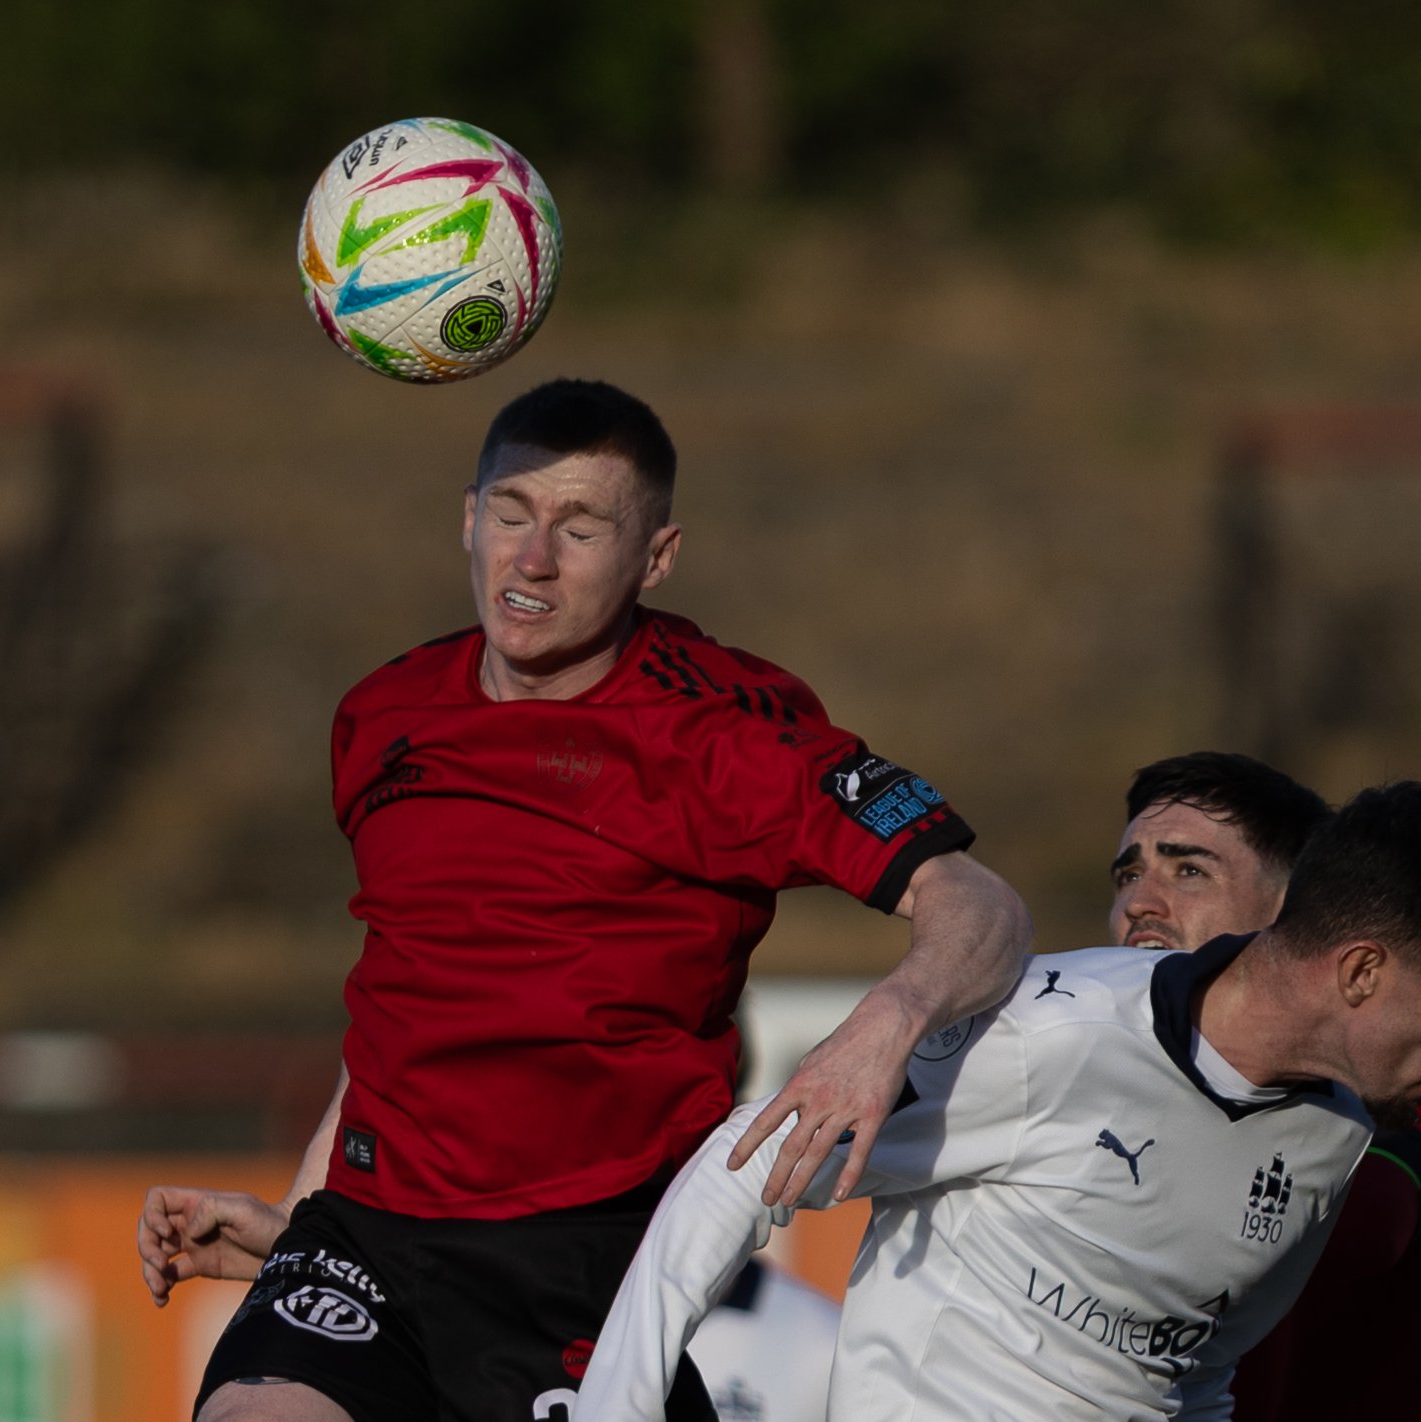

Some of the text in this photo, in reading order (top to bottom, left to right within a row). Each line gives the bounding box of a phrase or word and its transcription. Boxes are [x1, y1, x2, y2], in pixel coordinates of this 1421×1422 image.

[860, 791, 903, 826] LEAGUE
[874, 797, 928, 838] IRELAND
[1241, 1211, 1283, 1244] 1930
[1027, 1267, 1219, 1356] WhiteBO
